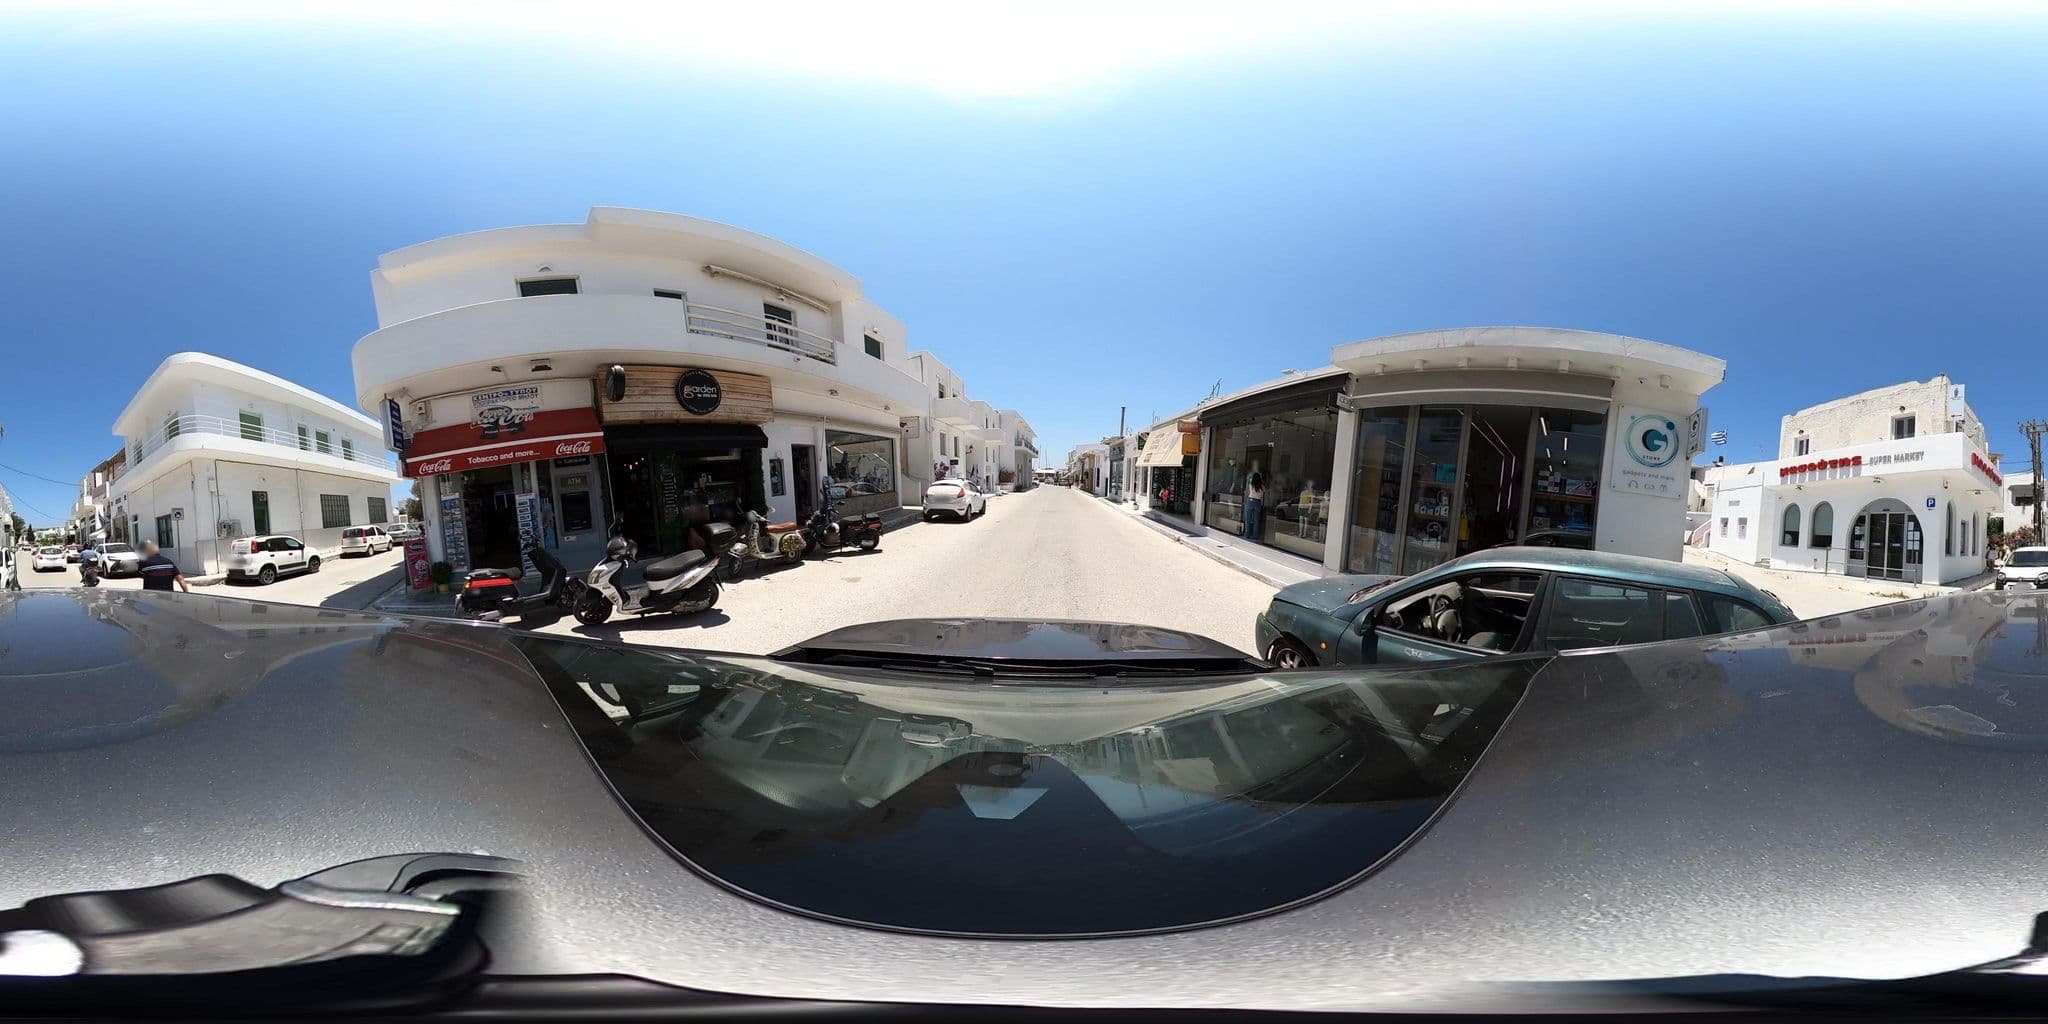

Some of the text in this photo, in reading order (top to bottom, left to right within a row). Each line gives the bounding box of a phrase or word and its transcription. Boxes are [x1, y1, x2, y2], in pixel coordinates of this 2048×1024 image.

[683, 384, 717, 399] garden
[467, 455, 499, 464] Tobacco
[500, 451, 514, 460] and
[1869, 451, 1925, 466] SUPER MARKET
